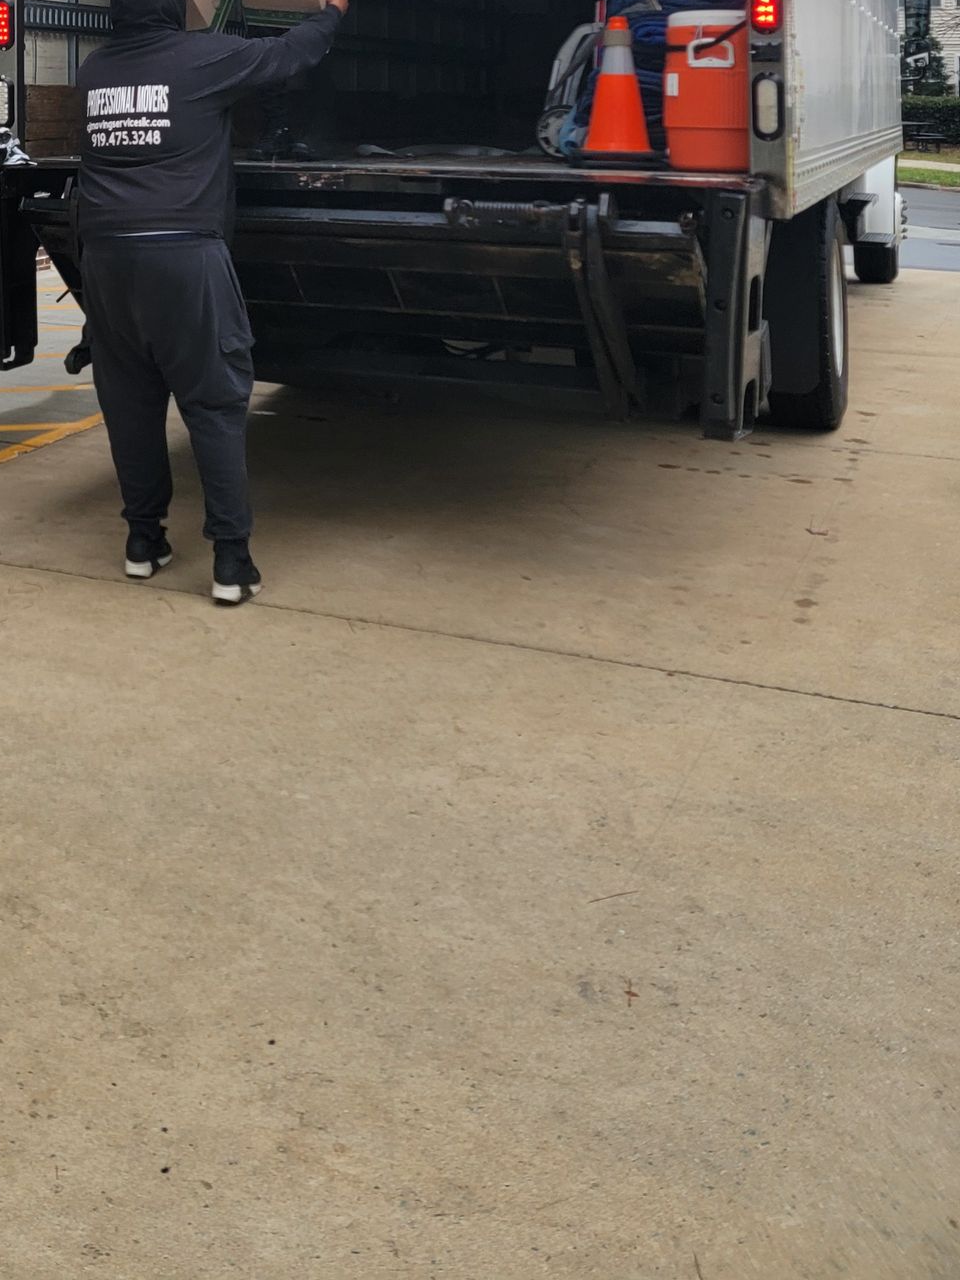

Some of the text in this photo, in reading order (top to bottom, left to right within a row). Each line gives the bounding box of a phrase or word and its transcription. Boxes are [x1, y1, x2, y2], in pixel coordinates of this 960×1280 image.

[87, 84, 169, 117] PROFESSIONAL MOVERS
[91, 129, 161, 147] 919.475.3248
